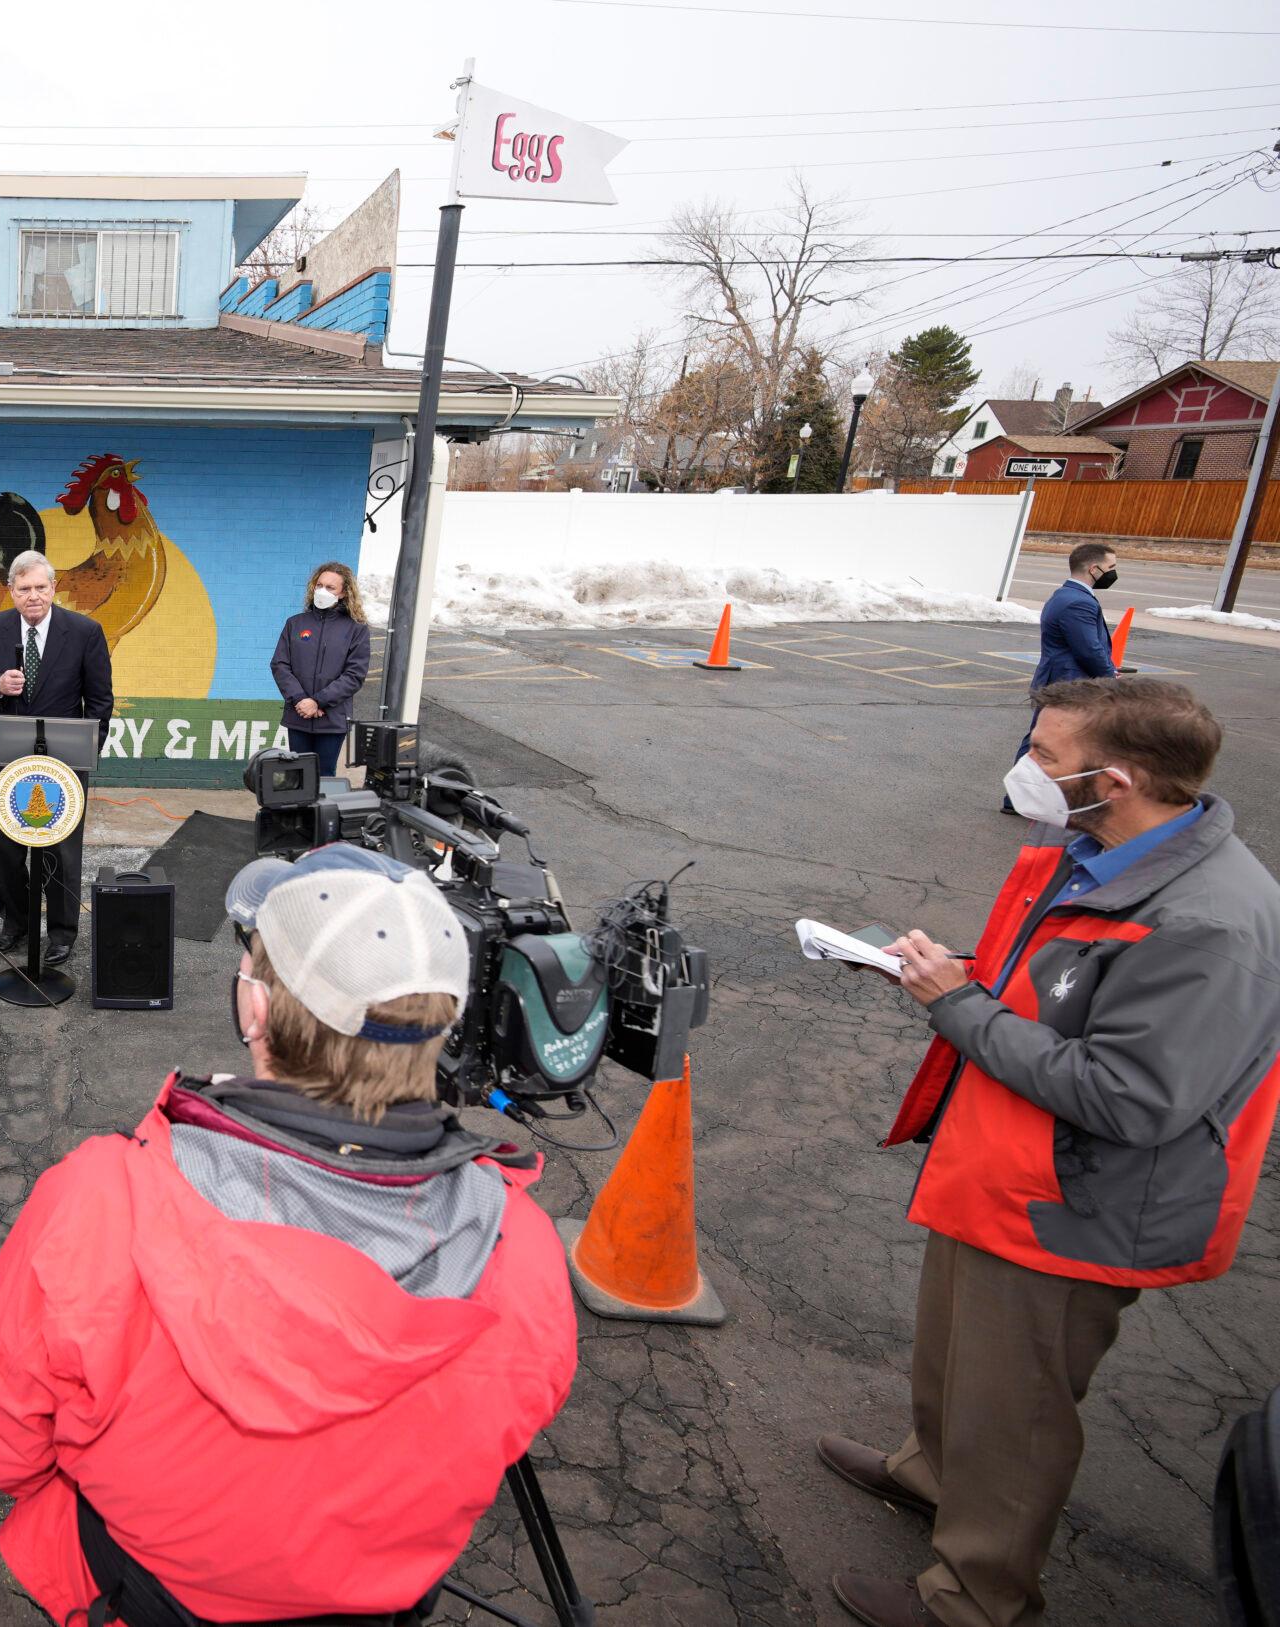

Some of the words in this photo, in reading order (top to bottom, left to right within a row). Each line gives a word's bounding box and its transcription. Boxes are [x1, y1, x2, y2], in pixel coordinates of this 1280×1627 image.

[492, 112, 565, 184] Eggs
[1012, 463, 1029, 472] ONE
[1031, 464, 1049, 472] WAY
[164, 718, 198, 759] &
[209, 719, 291, 760] MEA
[15, 764, 59, 777] DEPARTMENT
[58, 772, 67, 782] OF
[2, 775, 16, 798] STATES
[0, 799, 12, 826] UNITED
[63, 780, 77, 829] AGRICULTURE
